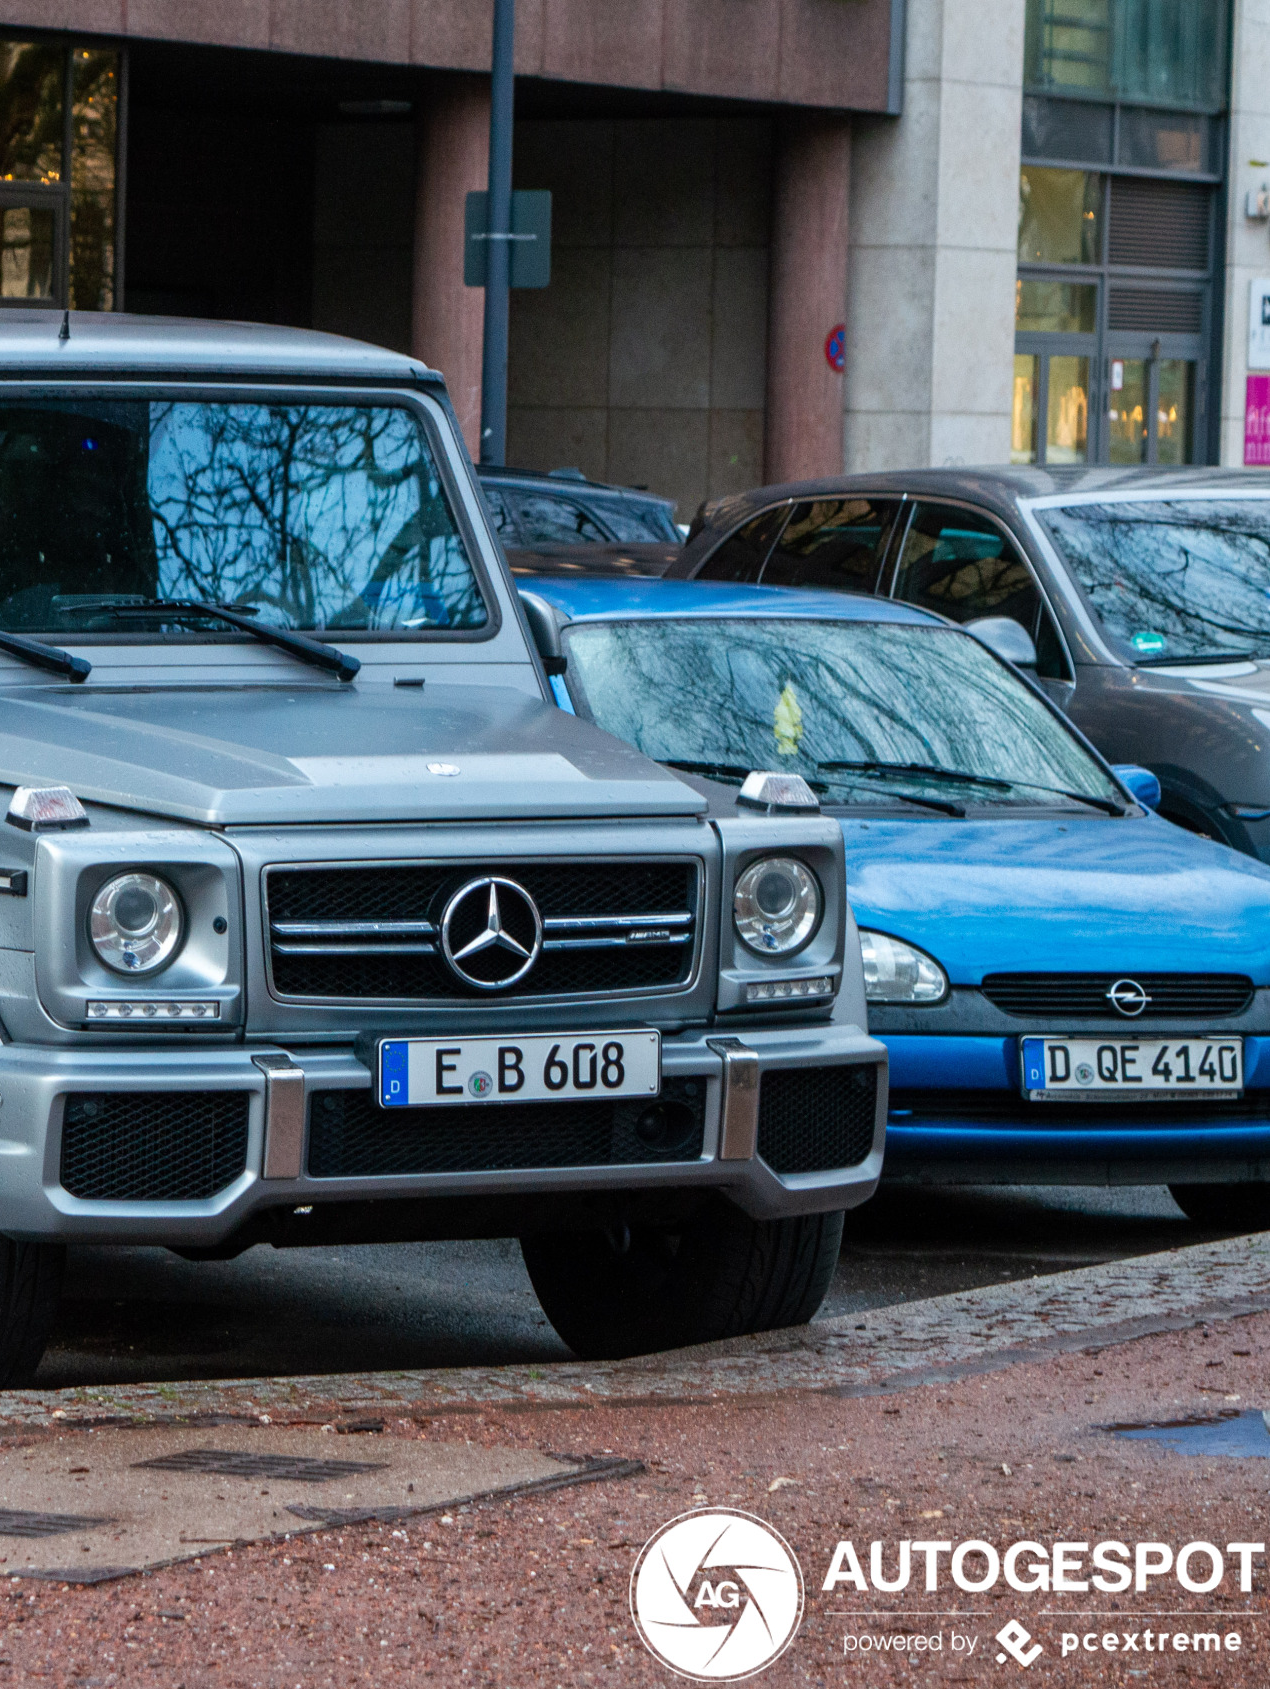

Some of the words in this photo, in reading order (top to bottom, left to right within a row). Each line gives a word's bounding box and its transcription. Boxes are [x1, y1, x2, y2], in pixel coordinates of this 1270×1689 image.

[436, 1048, 463, 1094] E
[498, 1046, 525, 1093] B
[543, 1041, 625, 1090] 608
[1031, 1069, 1039, 1080] D
[1048, 1046, 1070, 1083] D
[1097, 1045, 1142, 1083] QE
[1151, 1045, 1238, 1083] 4140
[390, 1080, 401, 1094] D
